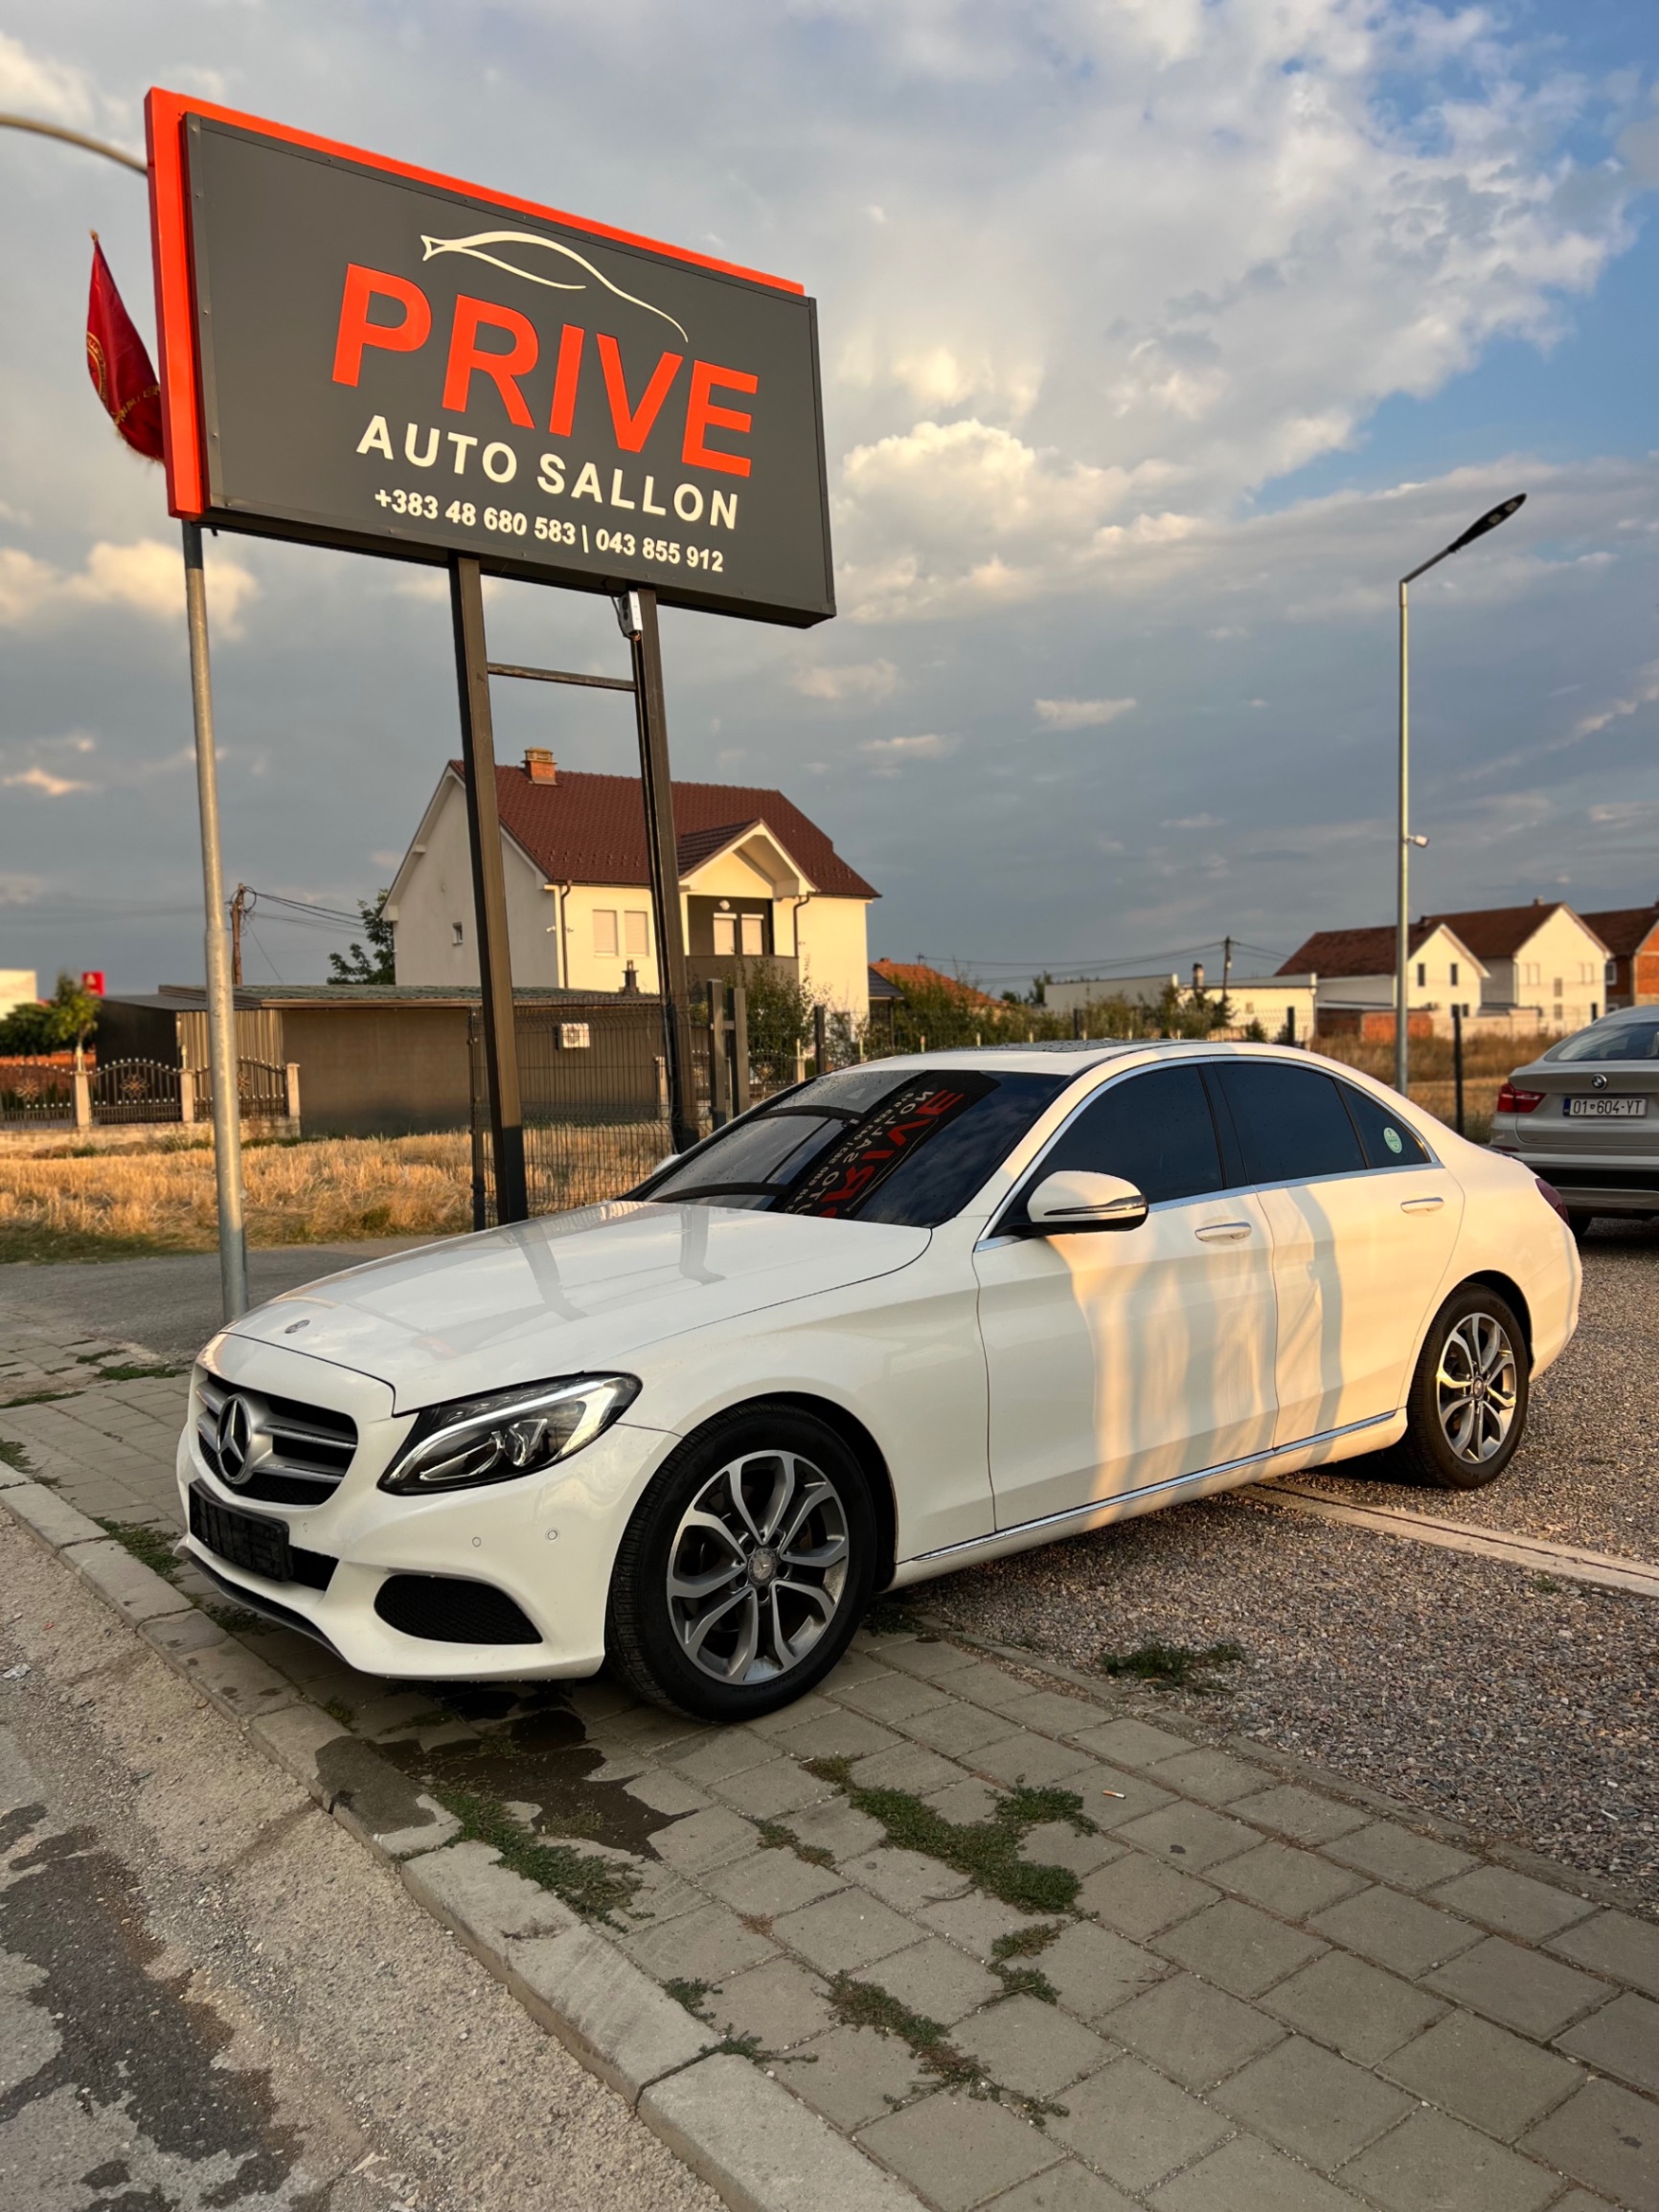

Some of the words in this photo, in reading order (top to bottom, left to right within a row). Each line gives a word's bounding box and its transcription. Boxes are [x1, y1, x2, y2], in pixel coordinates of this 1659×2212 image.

[331, 262, 759, 478] PRIVE
[355, 415, 518, 484] AUTO
[536, 453, 738, 530] SALLON
[375, 488, 439, 519] +383
[444, 500, 476, 527] 48
[483, 507, 528, 535] 680
[534, 516, 576, 545] 583
[596, 528, 636, 556] 043
[642, 537, 681, 564] 855
[686, 545, 723, 573] 912
